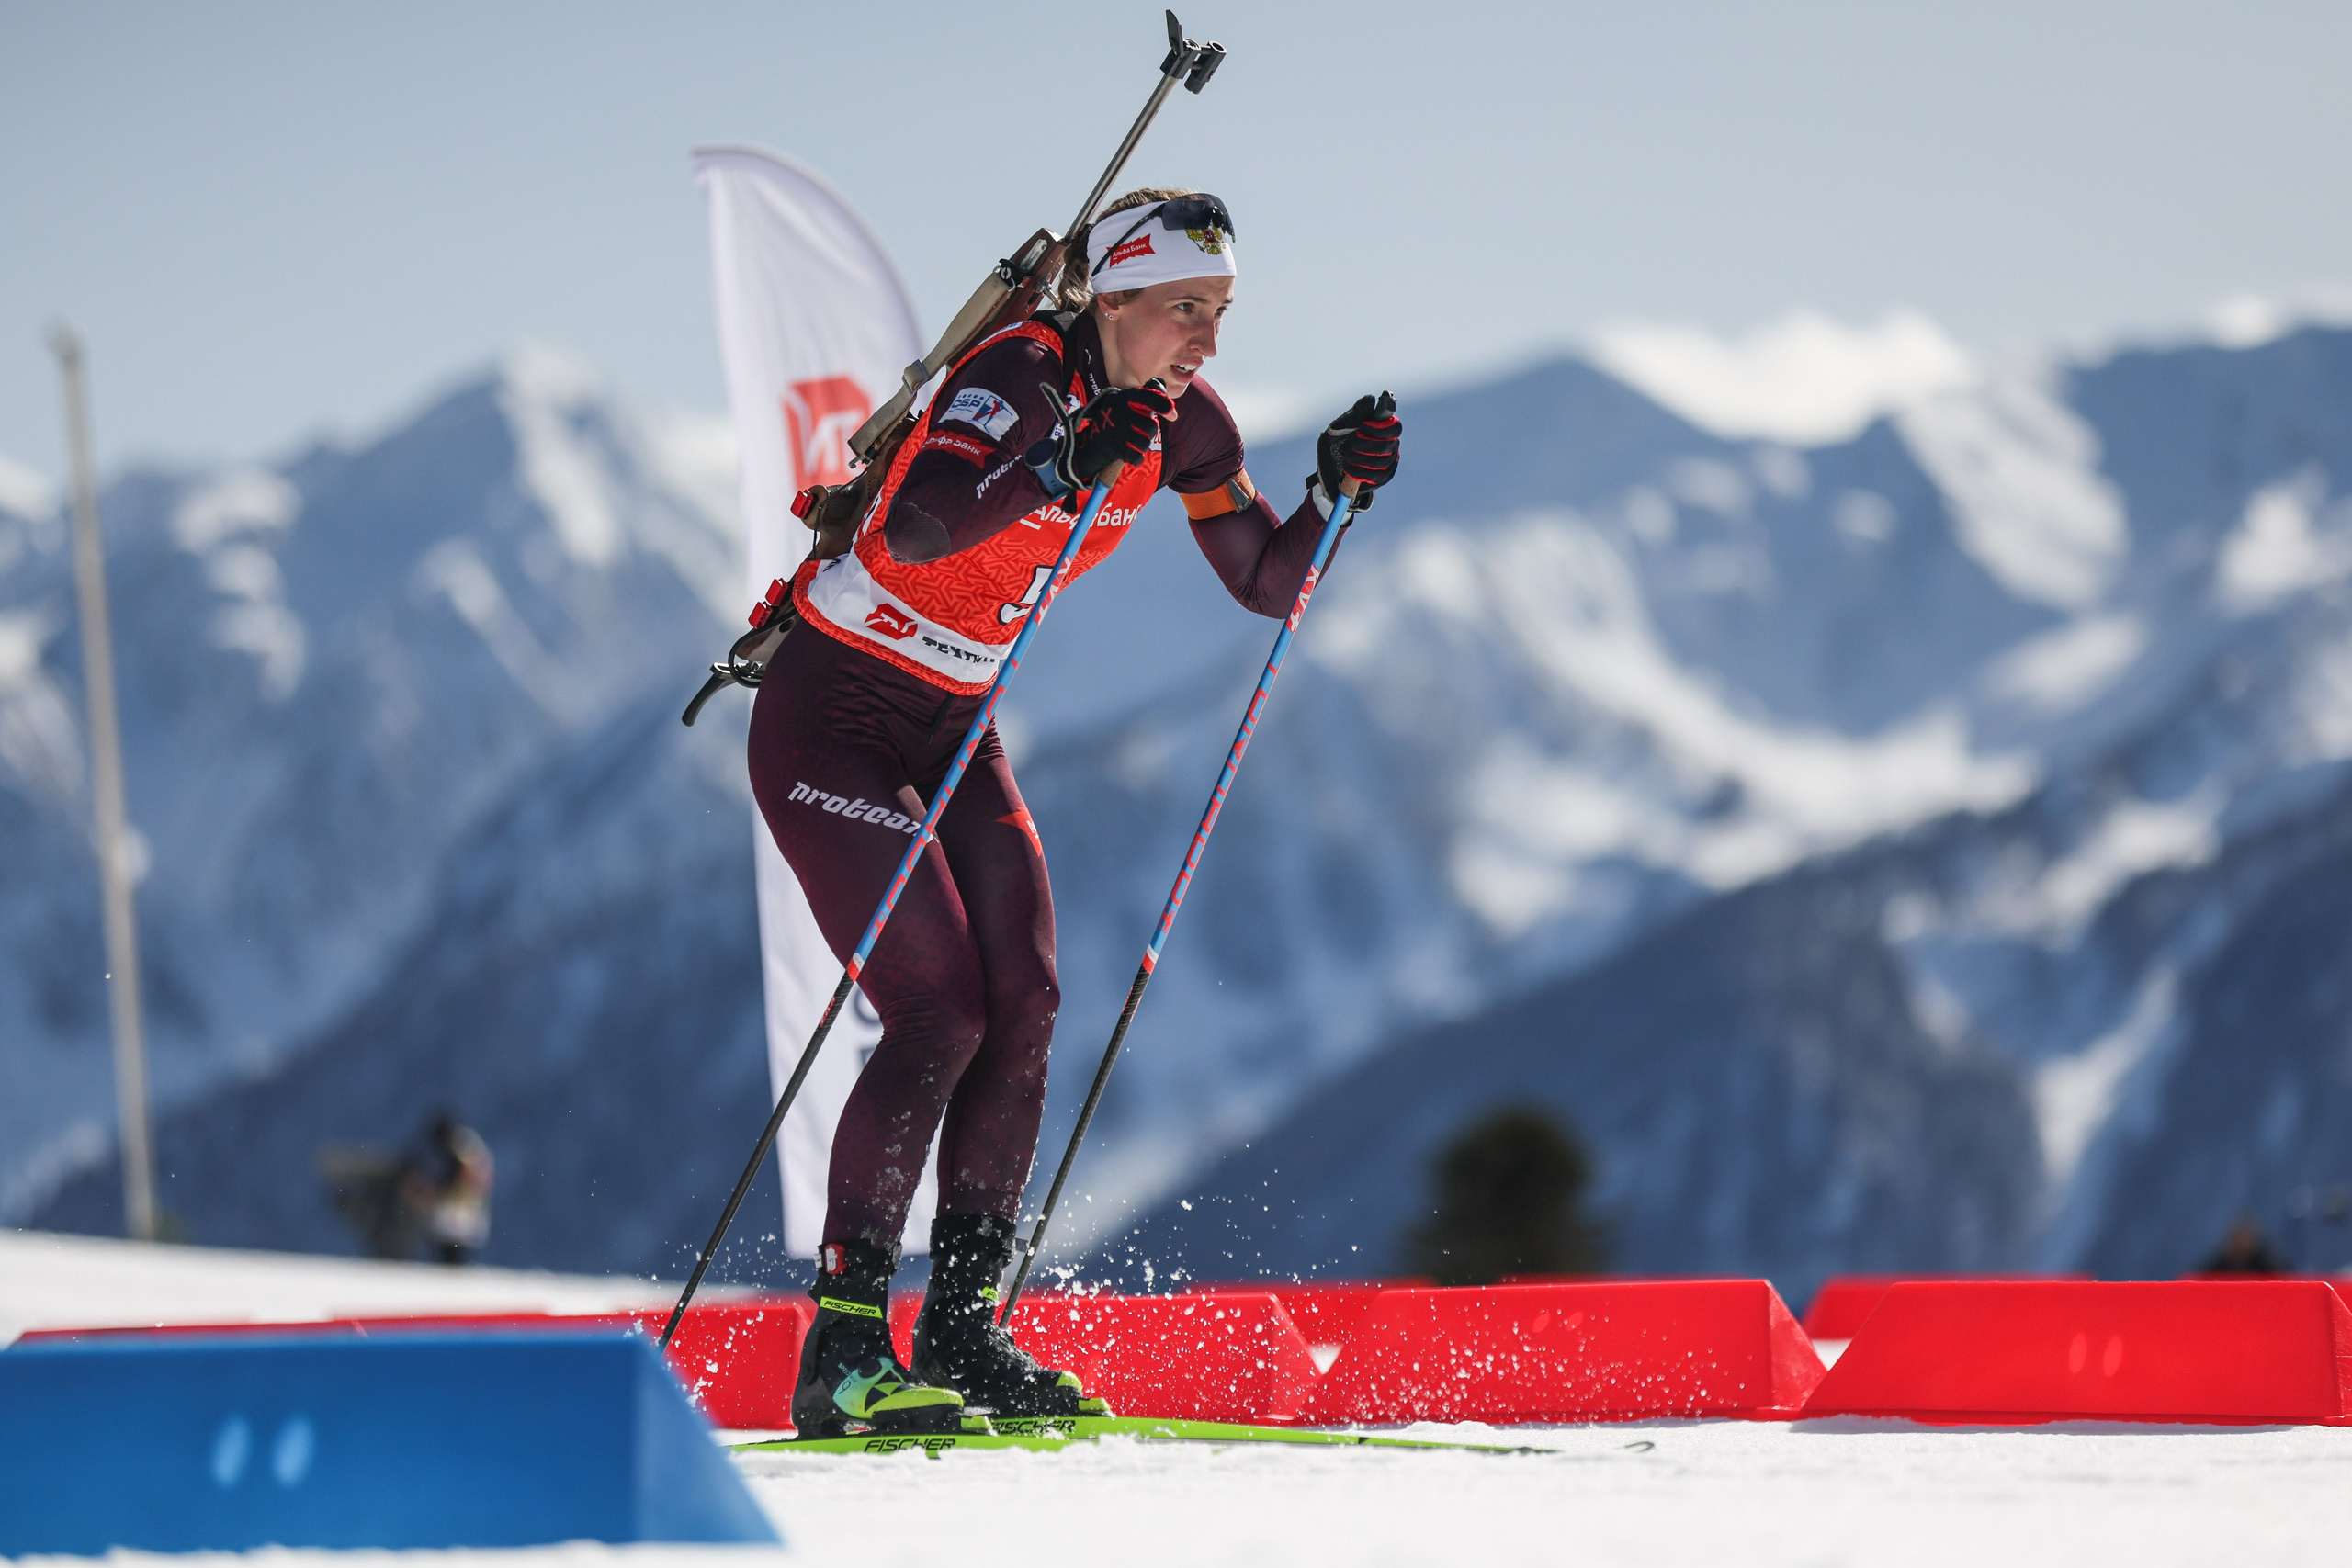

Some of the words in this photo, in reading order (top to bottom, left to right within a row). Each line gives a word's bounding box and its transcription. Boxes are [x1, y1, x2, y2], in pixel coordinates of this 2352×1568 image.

[1113, 248, 1131, 258] Альфа
[1131, 243, 1148, 253] Банк
[1288, 563, 1320, 633] KV+
[824, 1300, 876, 1315] FISCHER
[864, 1438, 956, 1452] FISCHER
